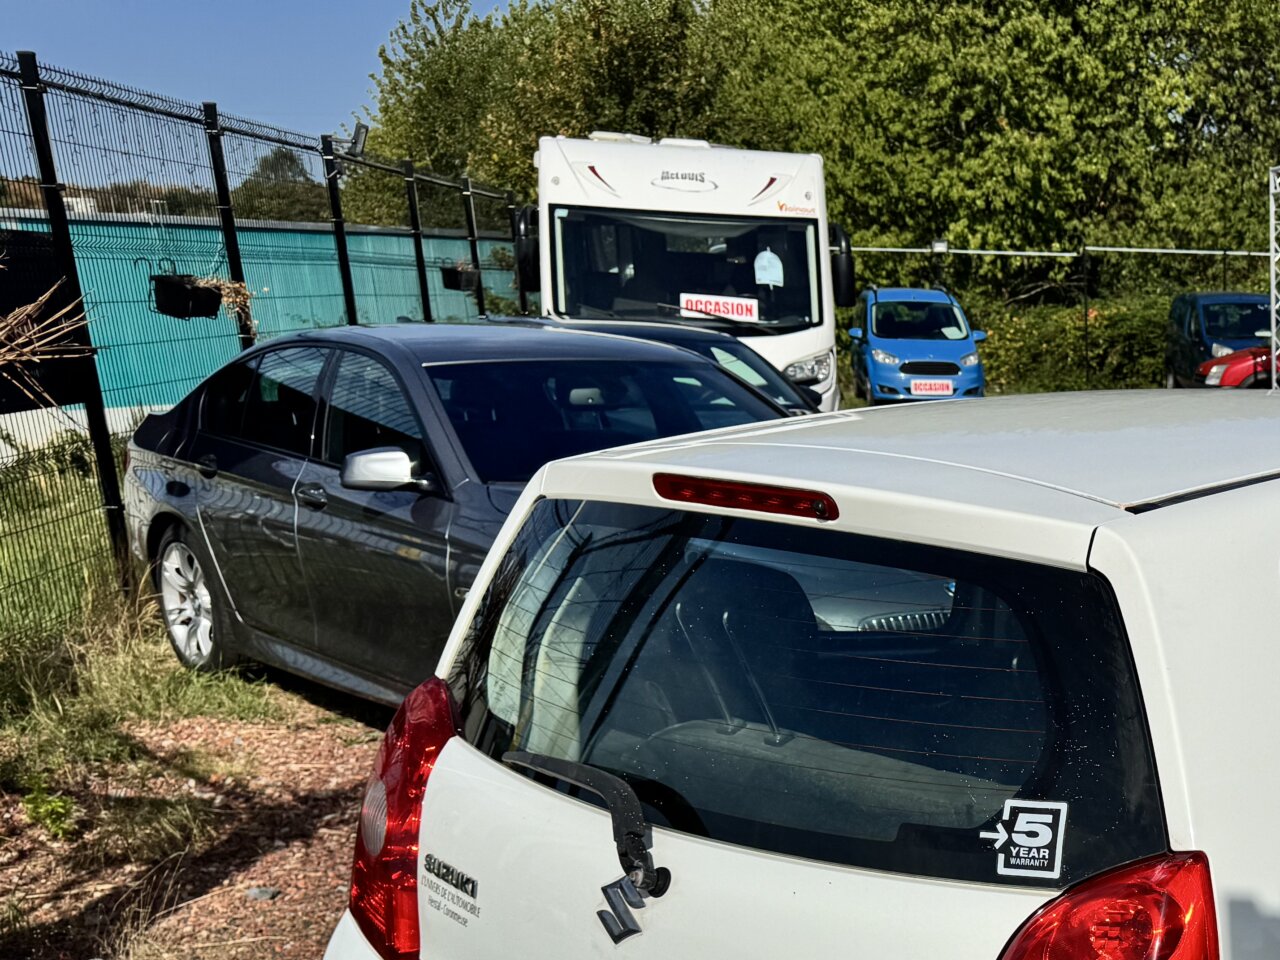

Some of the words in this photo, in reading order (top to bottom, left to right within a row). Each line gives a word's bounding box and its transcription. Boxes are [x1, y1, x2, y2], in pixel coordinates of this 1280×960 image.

[685, 299, 754, 317] OCCASION
[914, 382, 950, 392] OCCASION
[1011, 813, 1053, 848] 5
[1010, 846, 1049, 859] YEAR
[1010, 857, 1049, 867] WARRANTY
[424, 854, 478, 899] SUZUKI
